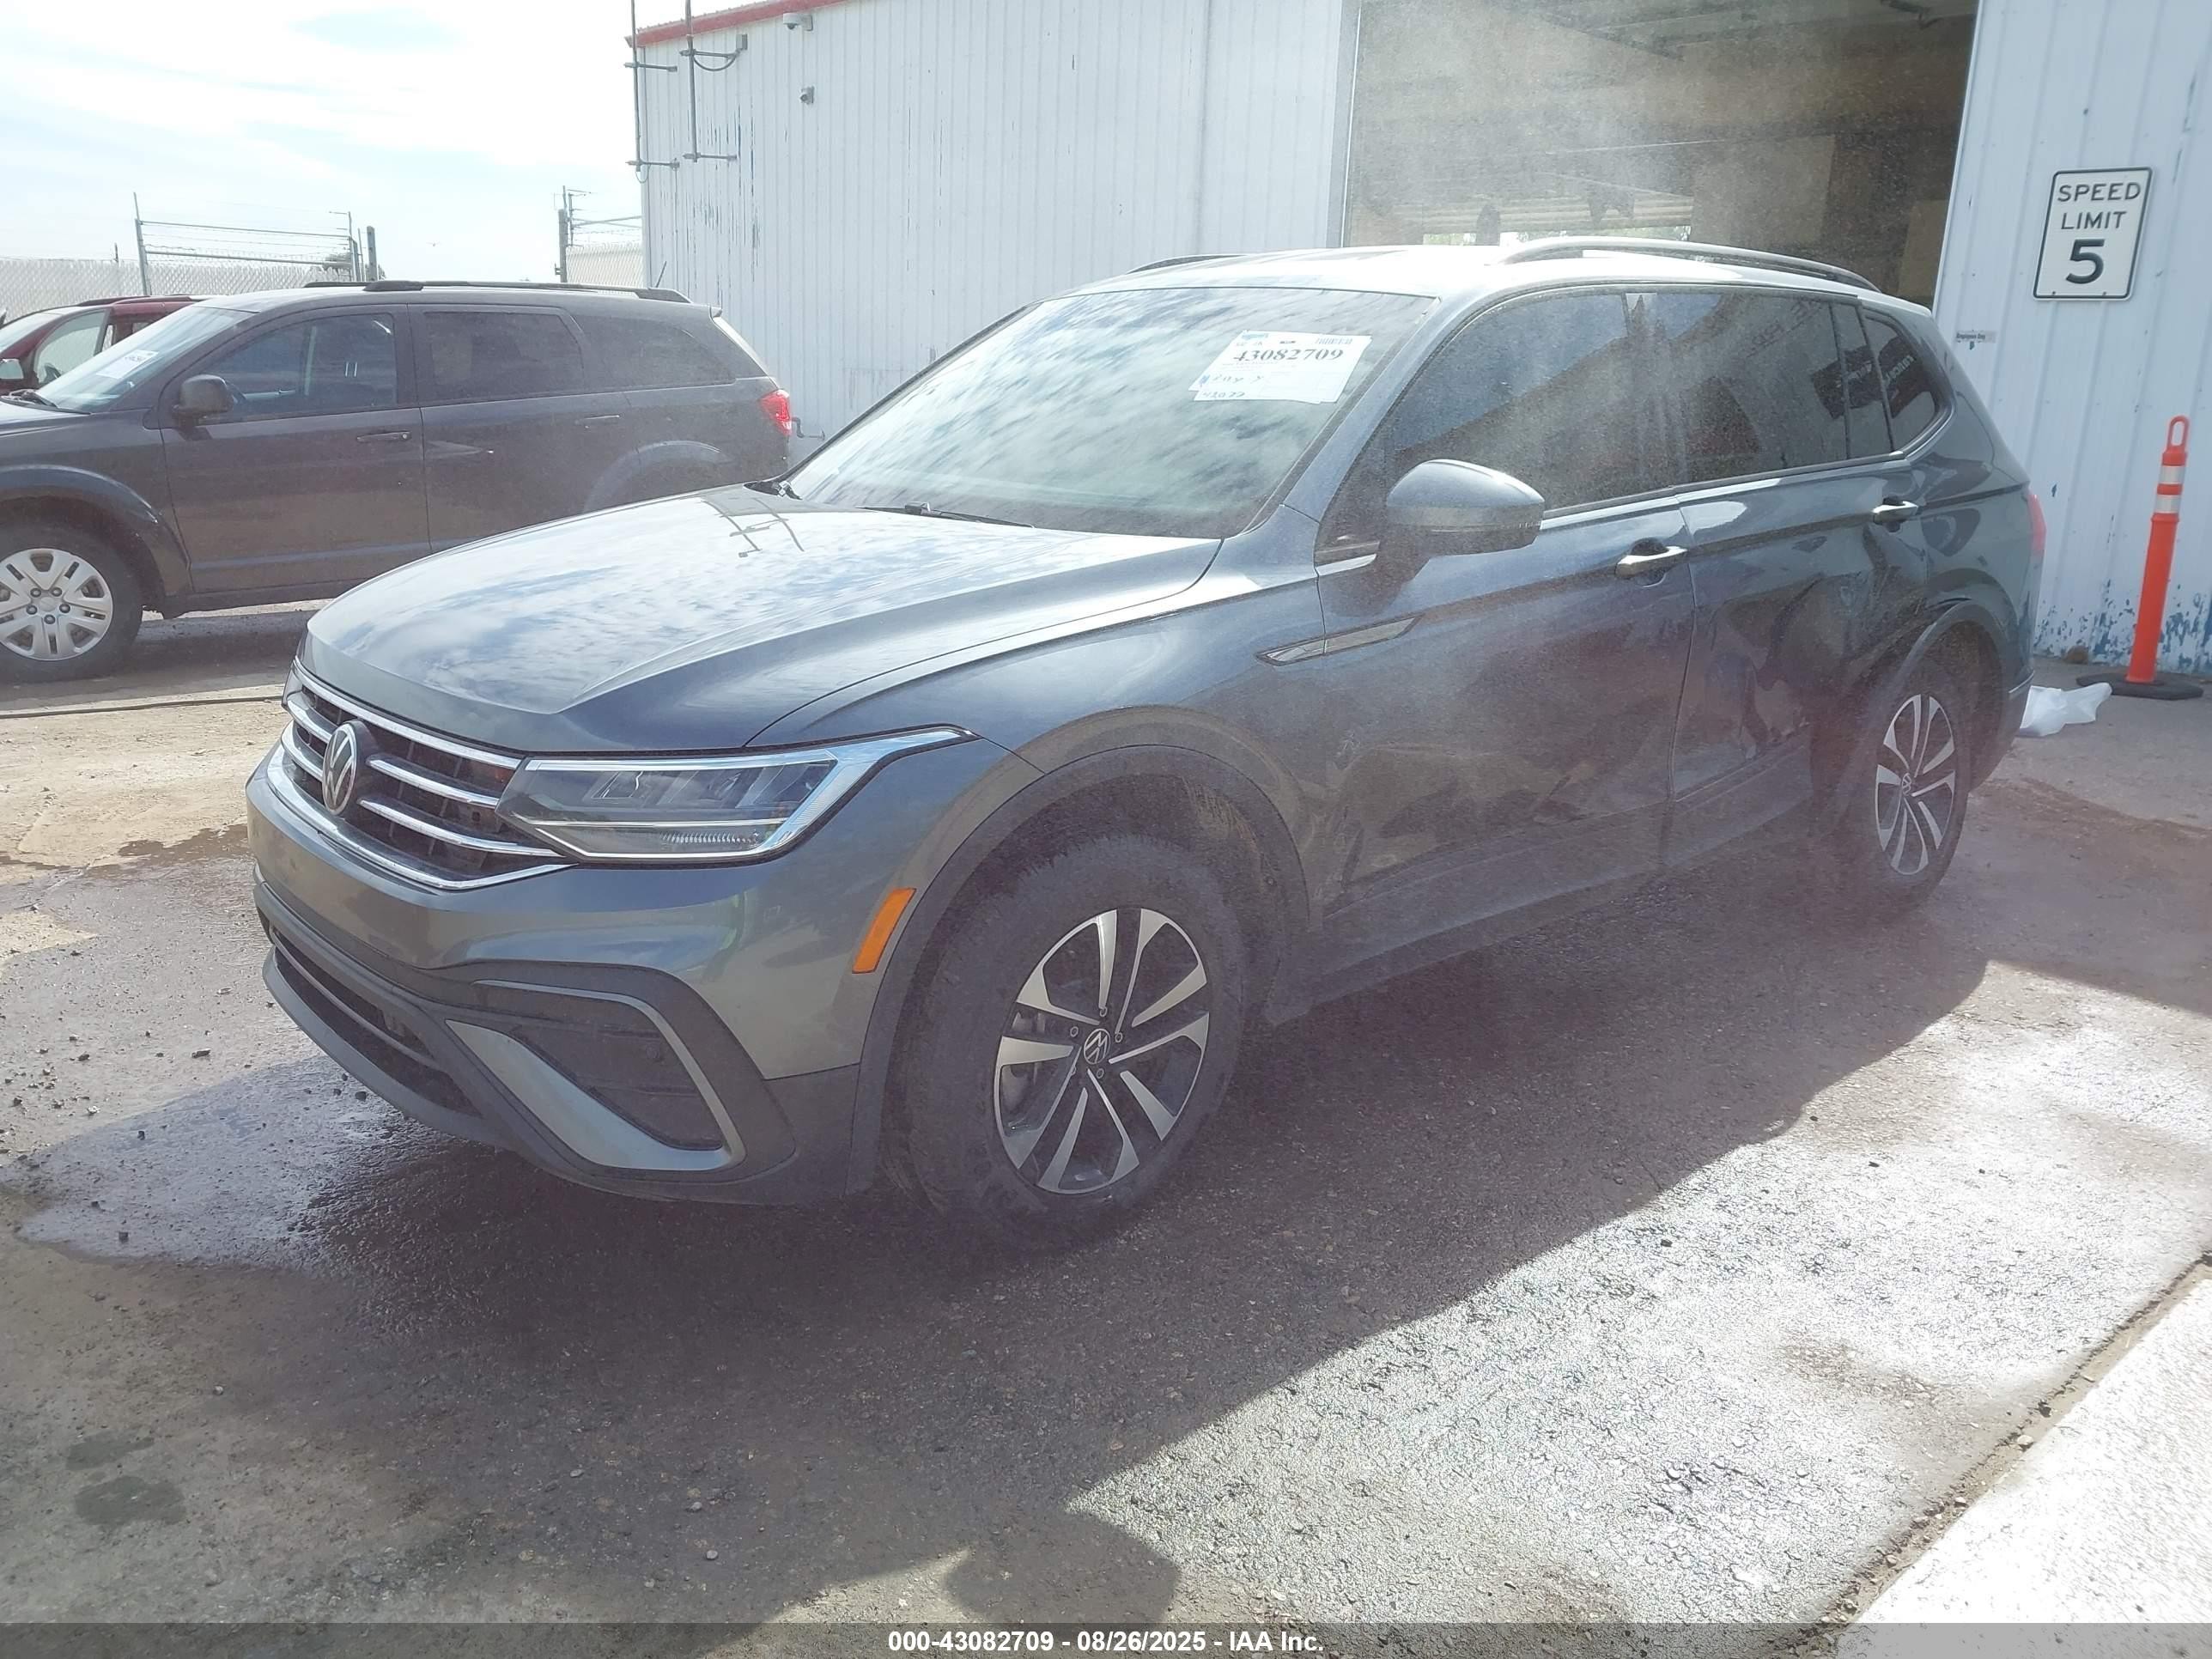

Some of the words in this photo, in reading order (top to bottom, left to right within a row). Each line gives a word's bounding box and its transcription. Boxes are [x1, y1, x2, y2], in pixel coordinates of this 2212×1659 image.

[2057, 182, 2142, 202] SPEED
[2061, 211, 2127, 229] LIMIT
[2065, 239, 2106, 284] 5
[1233, 349, 1344, 362] 43082709
